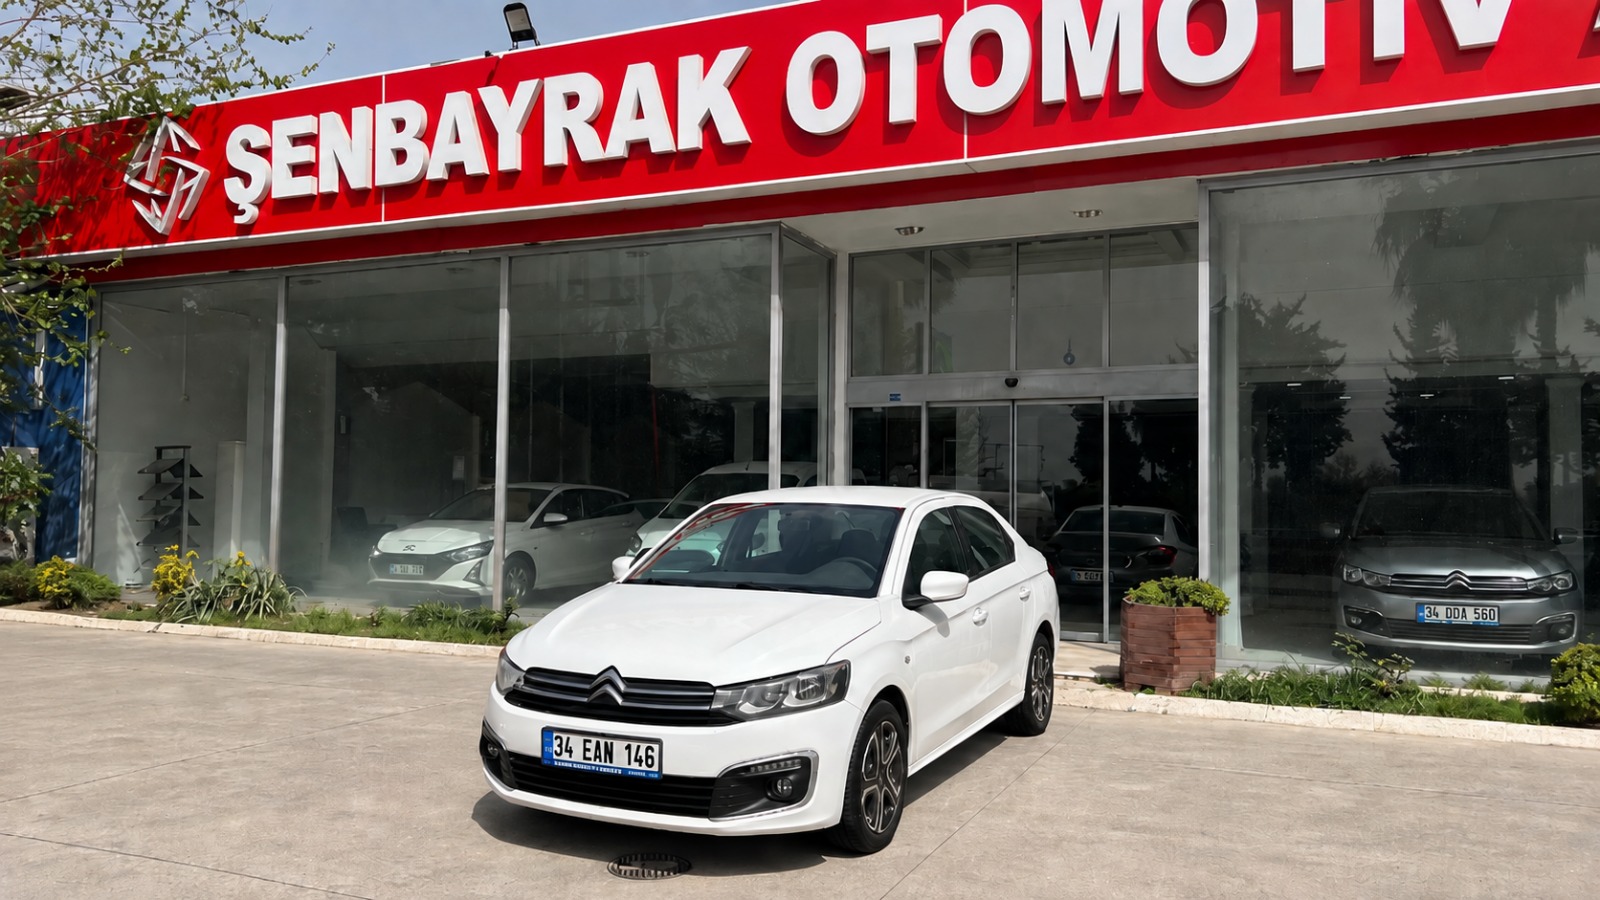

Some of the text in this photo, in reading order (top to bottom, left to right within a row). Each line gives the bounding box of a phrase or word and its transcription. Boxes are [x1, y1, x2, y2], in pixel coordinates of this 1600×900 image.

[224, 46, 752, 225] ŞENBAYRAK
[1425, 606, 1496, 621] 34 DDA 560
[554, 735, 573, 758] 34
[582, 738, 614, 764] EAN
[624, 743, 655, 769] 146
